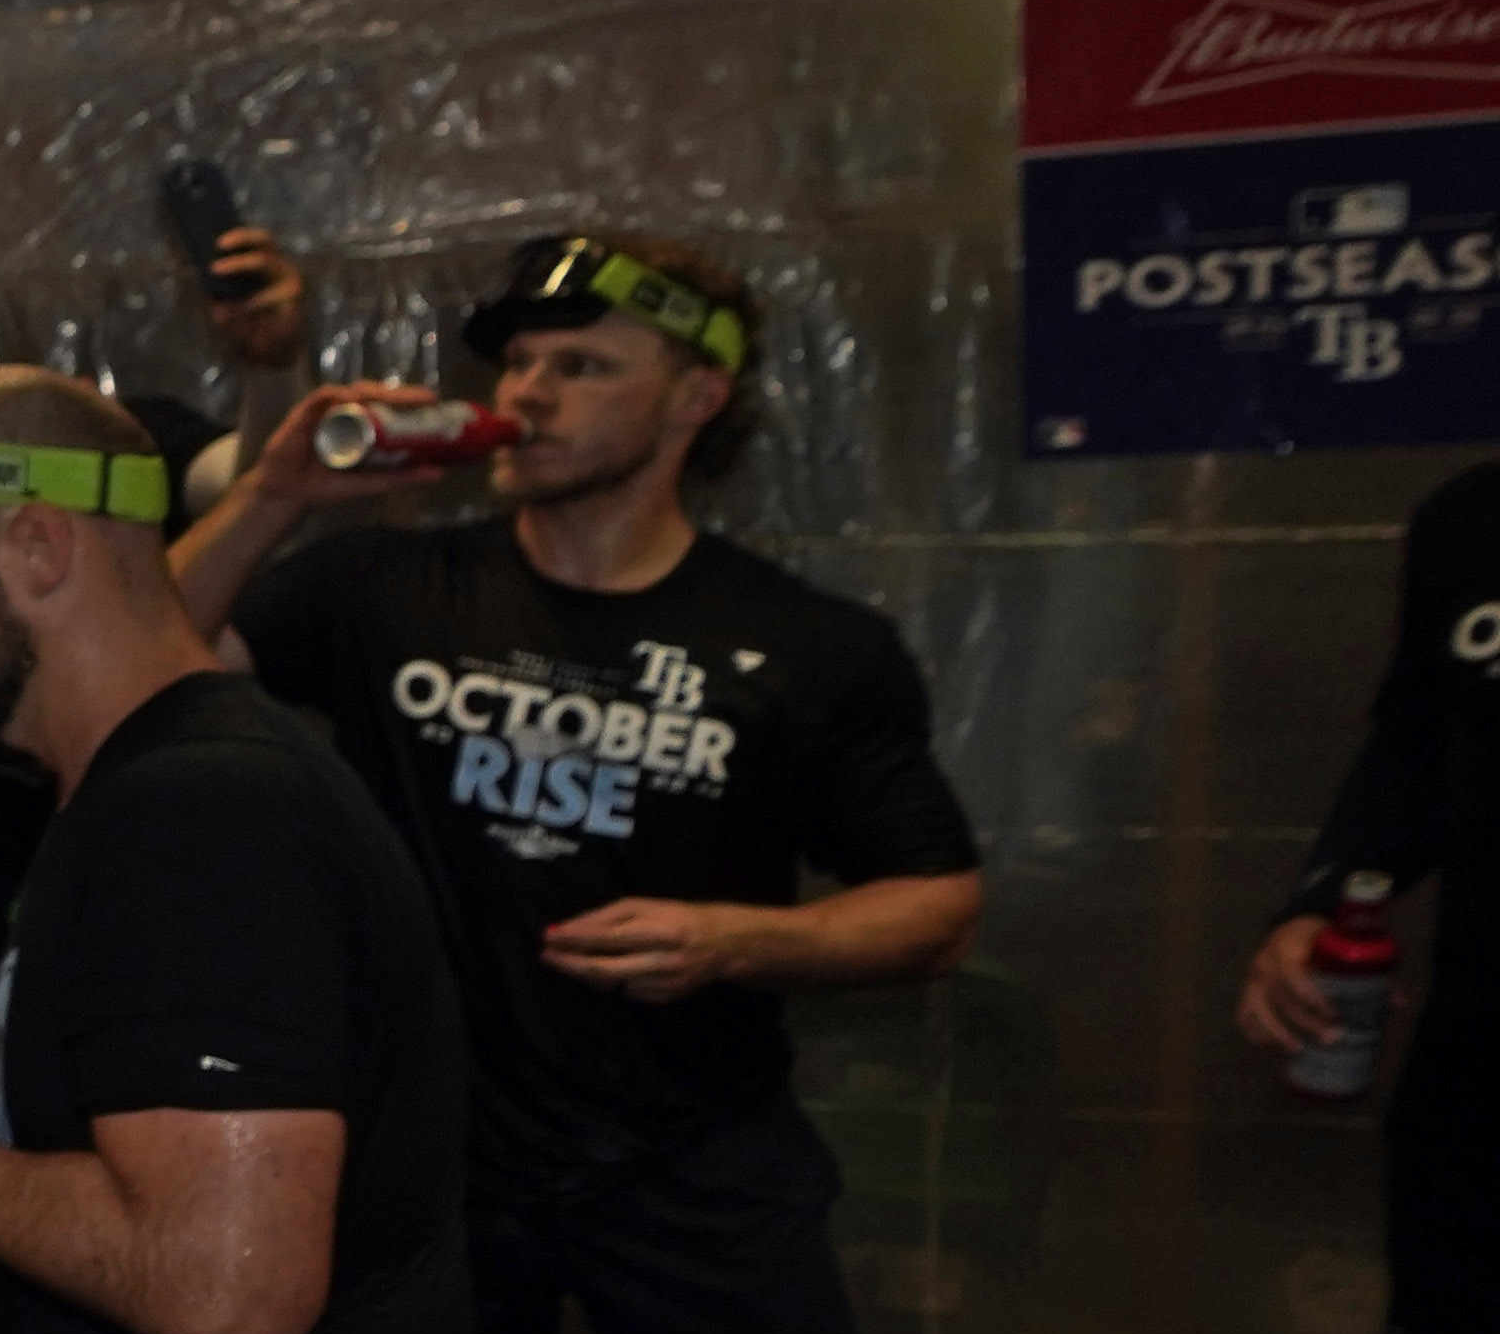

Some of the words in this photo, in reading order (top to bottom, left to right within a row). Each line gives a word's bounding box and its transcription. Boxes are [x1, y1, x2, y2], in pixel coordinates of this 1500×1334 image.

[1075, 233, 1500, 313] POSTSEAS
[391, 657, 738, 784] OCTOBER
[630, 639, 708, 713] TB
[448, 732, 643, 840] RISE
